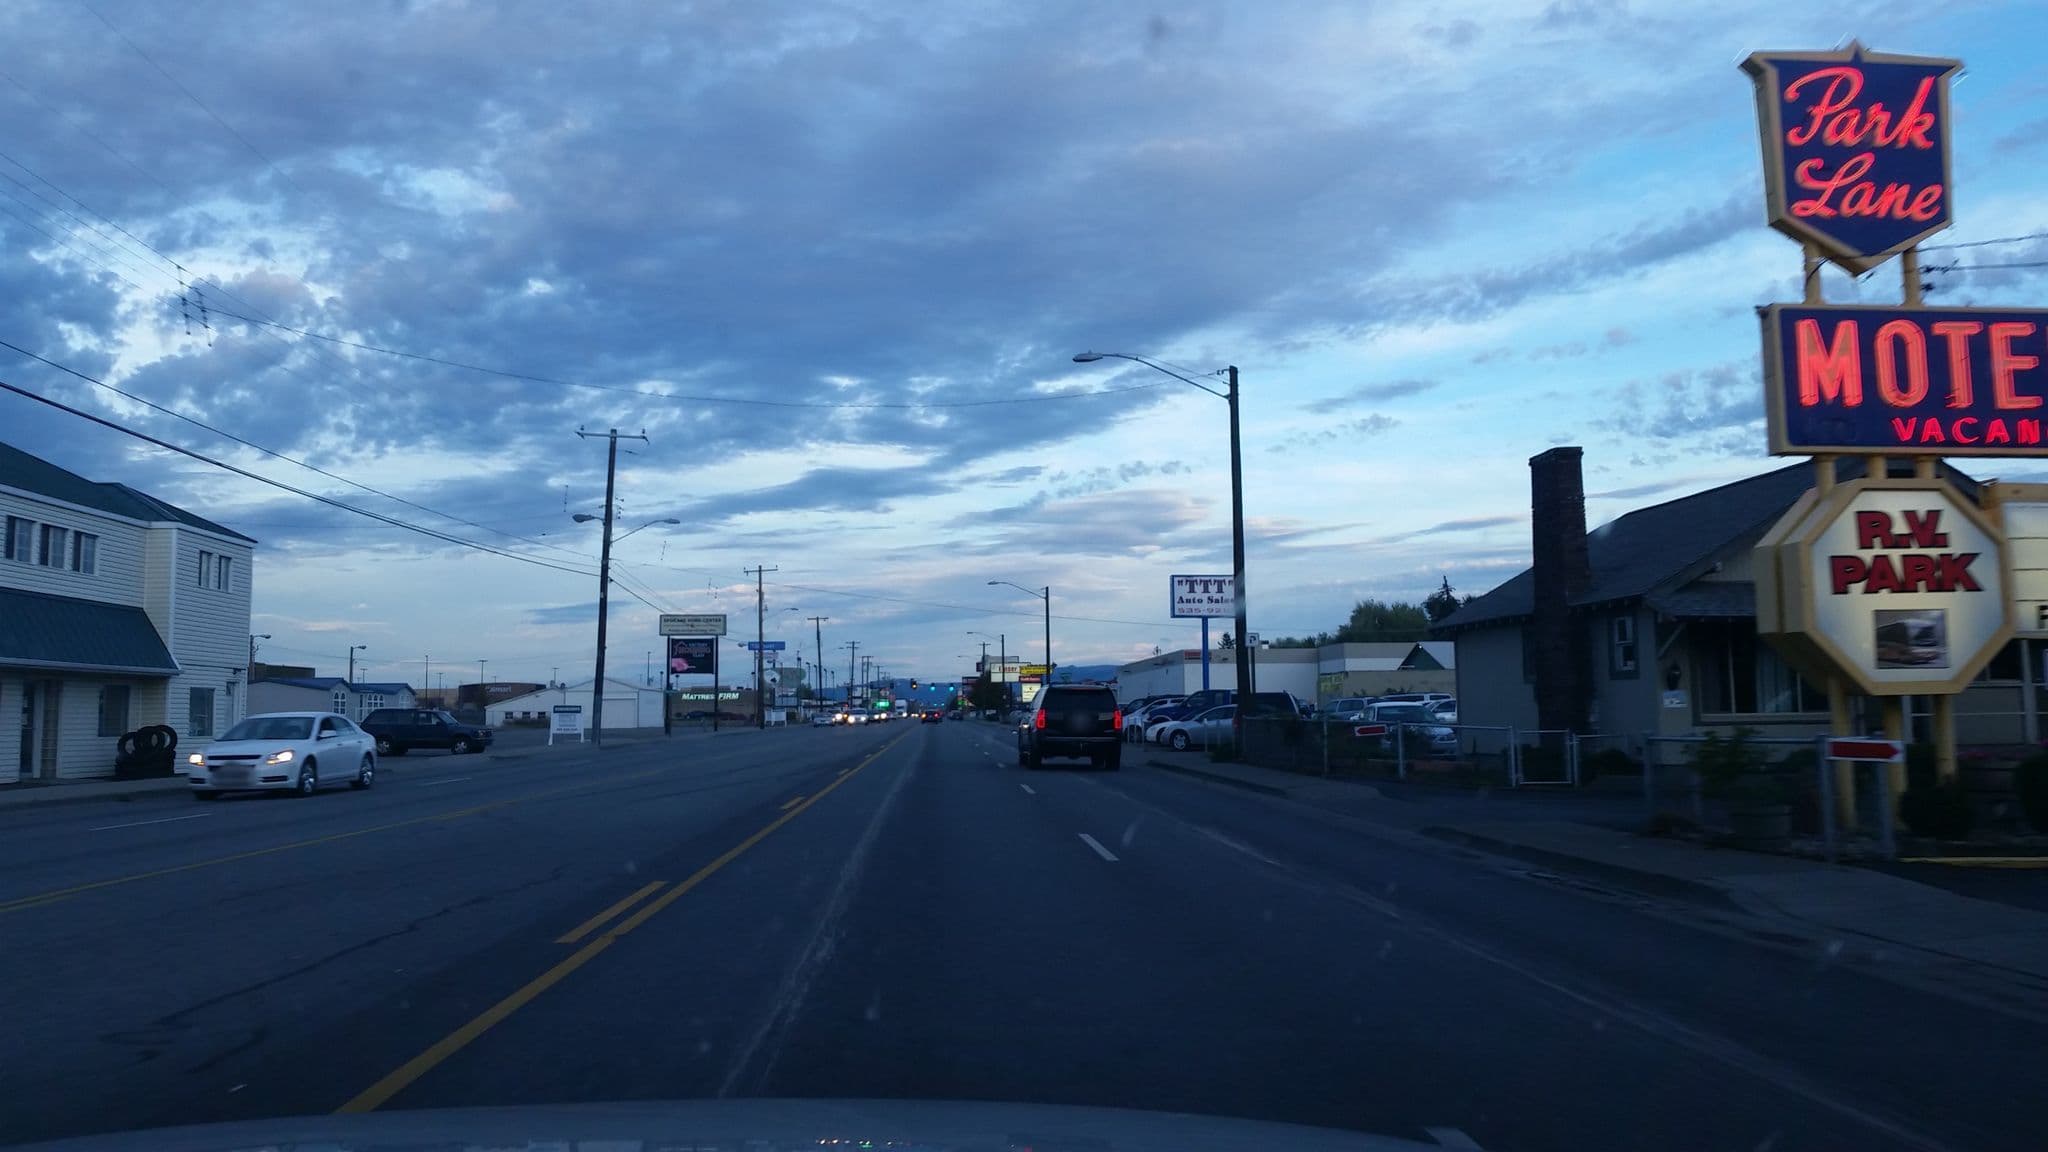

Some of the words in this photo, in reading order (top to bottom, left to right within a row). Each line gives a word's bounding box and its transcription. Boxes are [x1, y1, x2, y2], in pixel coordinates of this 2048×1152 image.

[1784, 66, 1937, 149] Park
[1790, 151, 1944, 222] Lane
[1794, 317, 2048, 410] MOTE
[1891, 416, 2048, 444] VACAN
[1854, 509, 1949, 549] R.V.
[1829, 552, 1985, 595] PARK
[1177, 596, 1204, 605] Auto
[682, 693, 716, 701] MATTRES
[718, 692, 739, 701] FIRM
